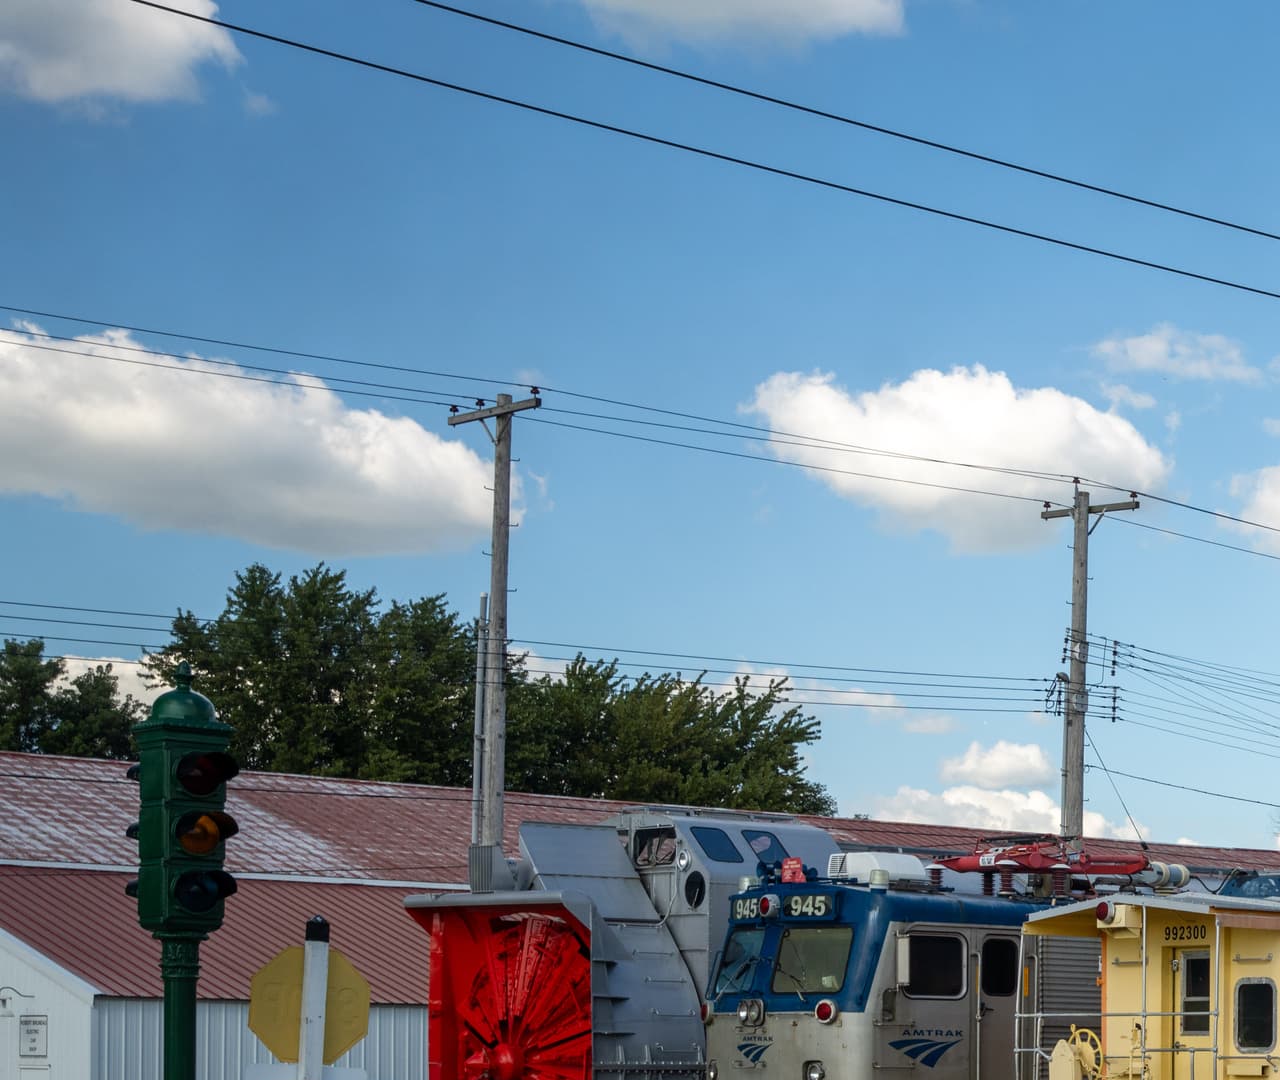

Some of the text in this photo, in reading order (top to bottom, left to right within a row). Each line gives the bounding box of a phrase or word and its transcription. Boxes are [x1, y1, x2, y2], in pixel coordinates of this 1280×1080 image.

[736, 898, 758, 919] 945
[790, 895, 826, 916] 945
[1164, 925, 1206, 941] 992300
[902, 1029, 964, 1037] AMTRAK
